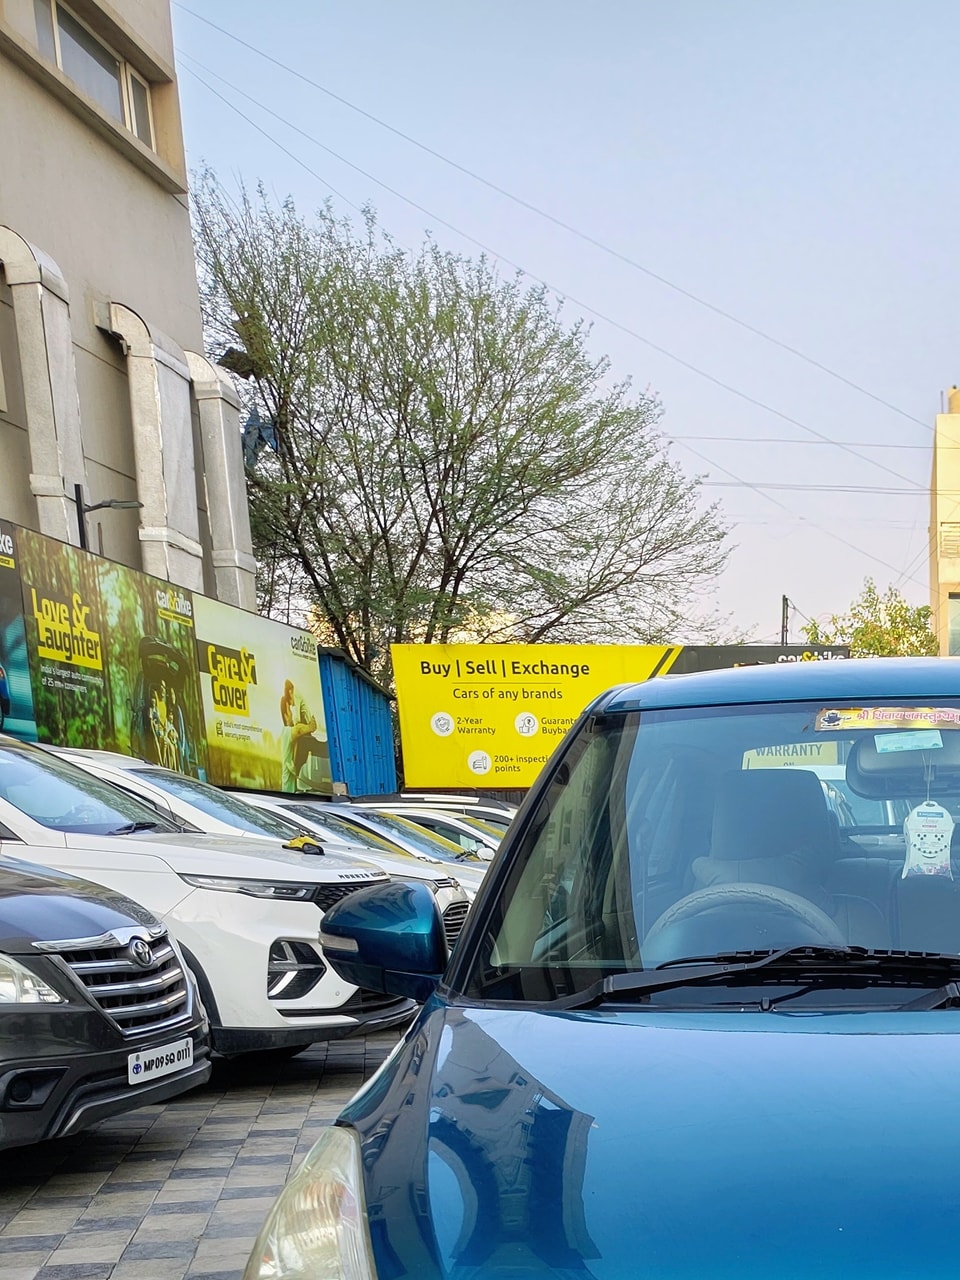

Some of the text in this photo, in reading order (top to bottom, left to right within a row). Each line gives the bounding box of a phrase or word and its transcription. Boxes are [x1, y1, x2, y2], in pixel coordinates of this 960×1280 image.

[31, 588, 90, 632] Love &
[156, 590, 192, 617] car&bike
[37, 621, 99, 662] Laughter
[208, 645, 256, 684] Care &
[420, 660, 450, 678] Buy
[466, 660, 497, 675] Sell
[511, 660, 590, 678] Exchange
[211, 676, 247, 711] Cover
[453, 688, 563, 701] Cars of any brands
[457, 717, 483, 725] 2-Year
[457, 727, 496, 736] Warranty
[755, 743, 823, 757] WARRANTY
[494, 755, 514, 763] 200+
[495, 764, 521, 772] points
